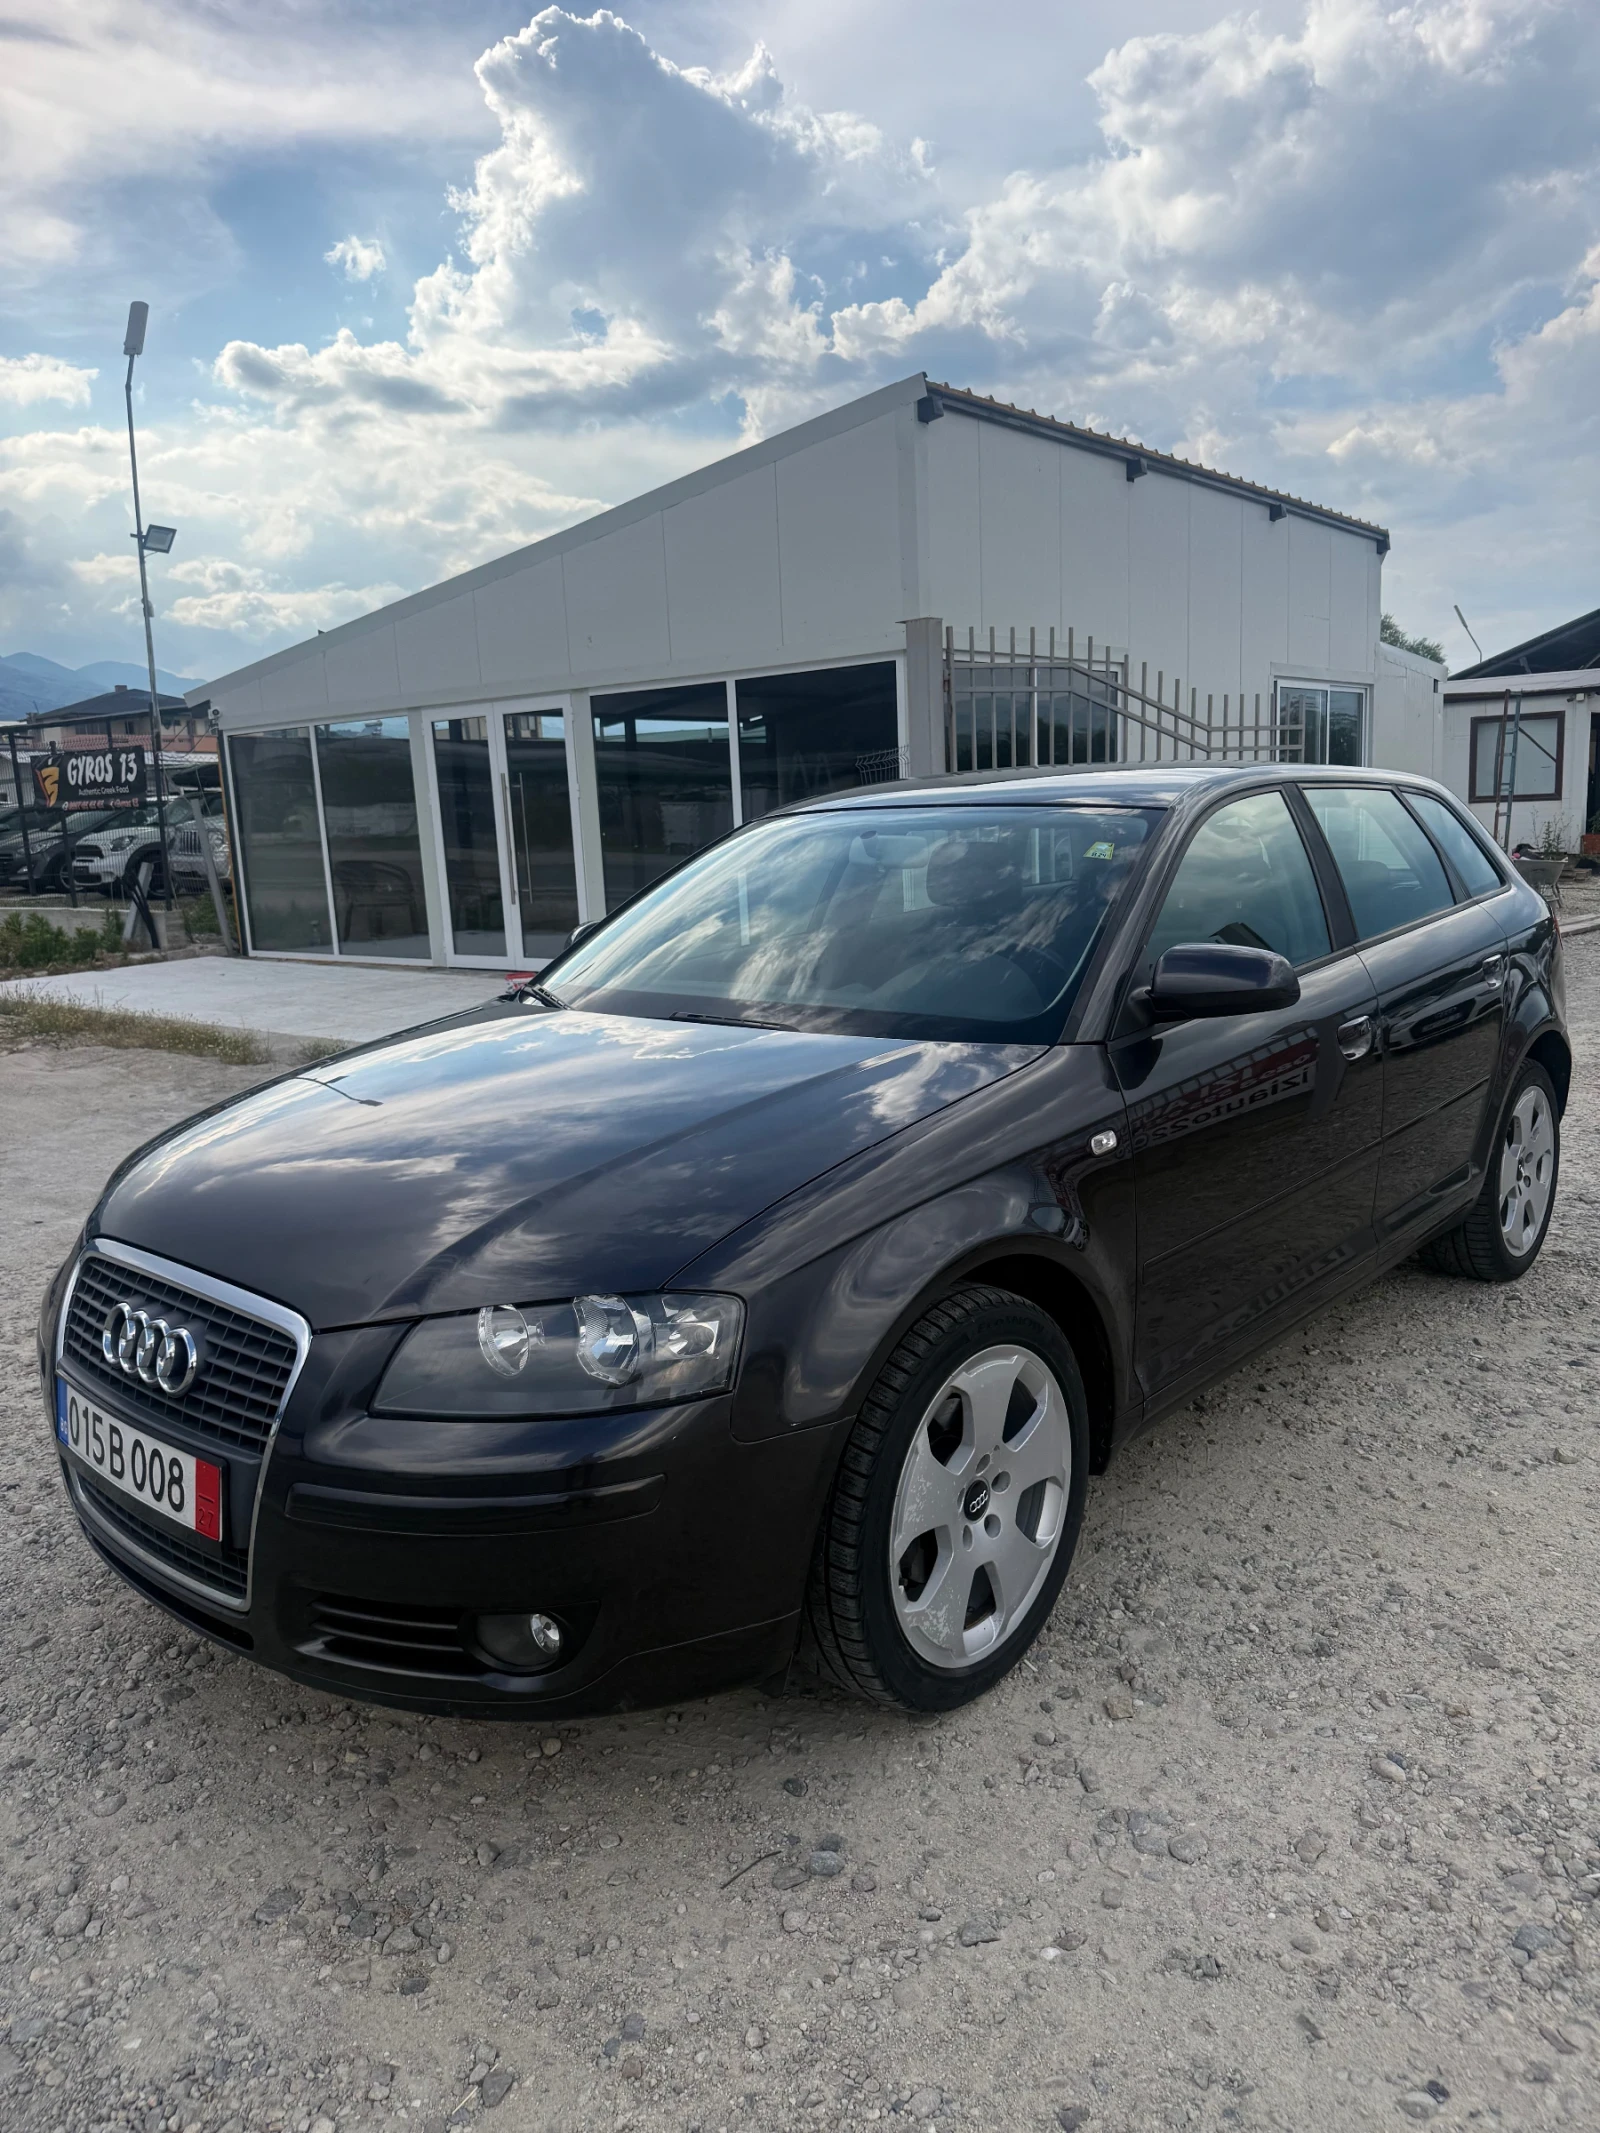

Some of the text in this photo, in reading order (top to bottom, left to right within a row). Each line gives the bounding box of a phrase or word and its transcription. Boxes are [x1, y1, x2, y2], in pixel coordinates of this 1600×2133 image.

[67, 752, 138, 786] GYROS 13
[79, 785, 130, 796] Authentic Greek Food
[198, 1507, 214, 1529] 27
